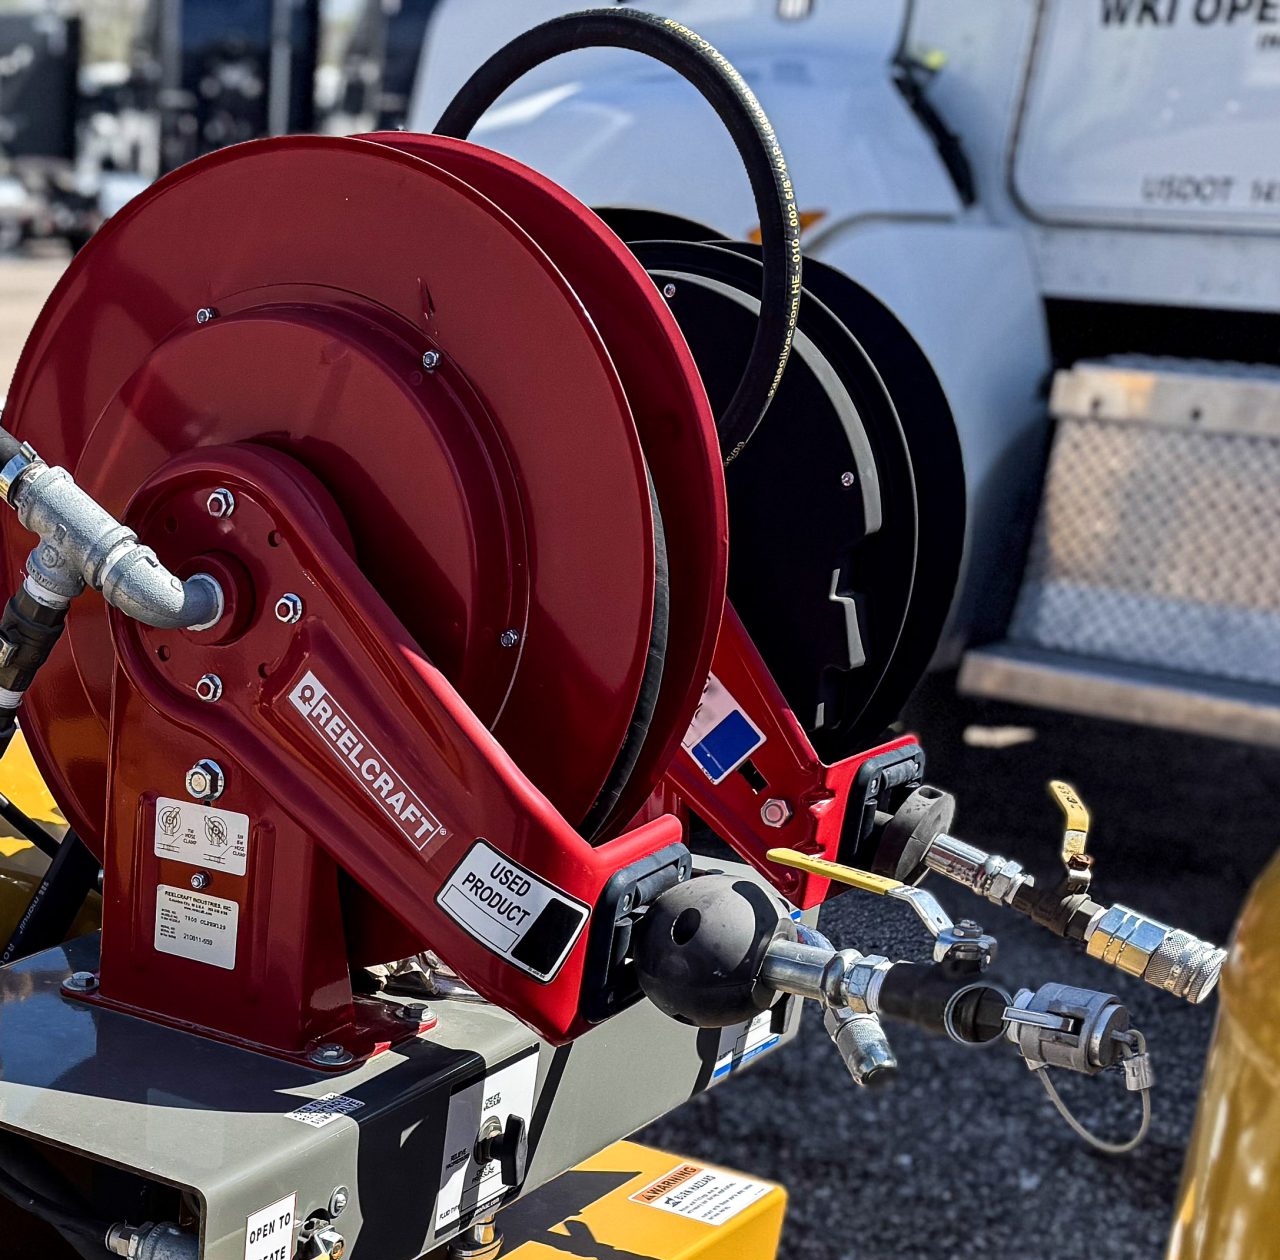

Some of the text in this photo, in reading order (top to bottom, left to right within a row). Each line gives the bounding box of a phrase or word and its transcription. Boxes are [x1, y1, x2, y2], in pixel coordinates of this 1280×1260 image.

[1141, 175, 1234, 203] USDOT
[311, 699, 435, 839] REELCRAFT
[490, 862, 532, 897] USED
[462, 871, 532, 926] PRODUCT
[645, 1165, 699, 1196] WARNING
[249, 1212, 291, 1244] OPEN TO
